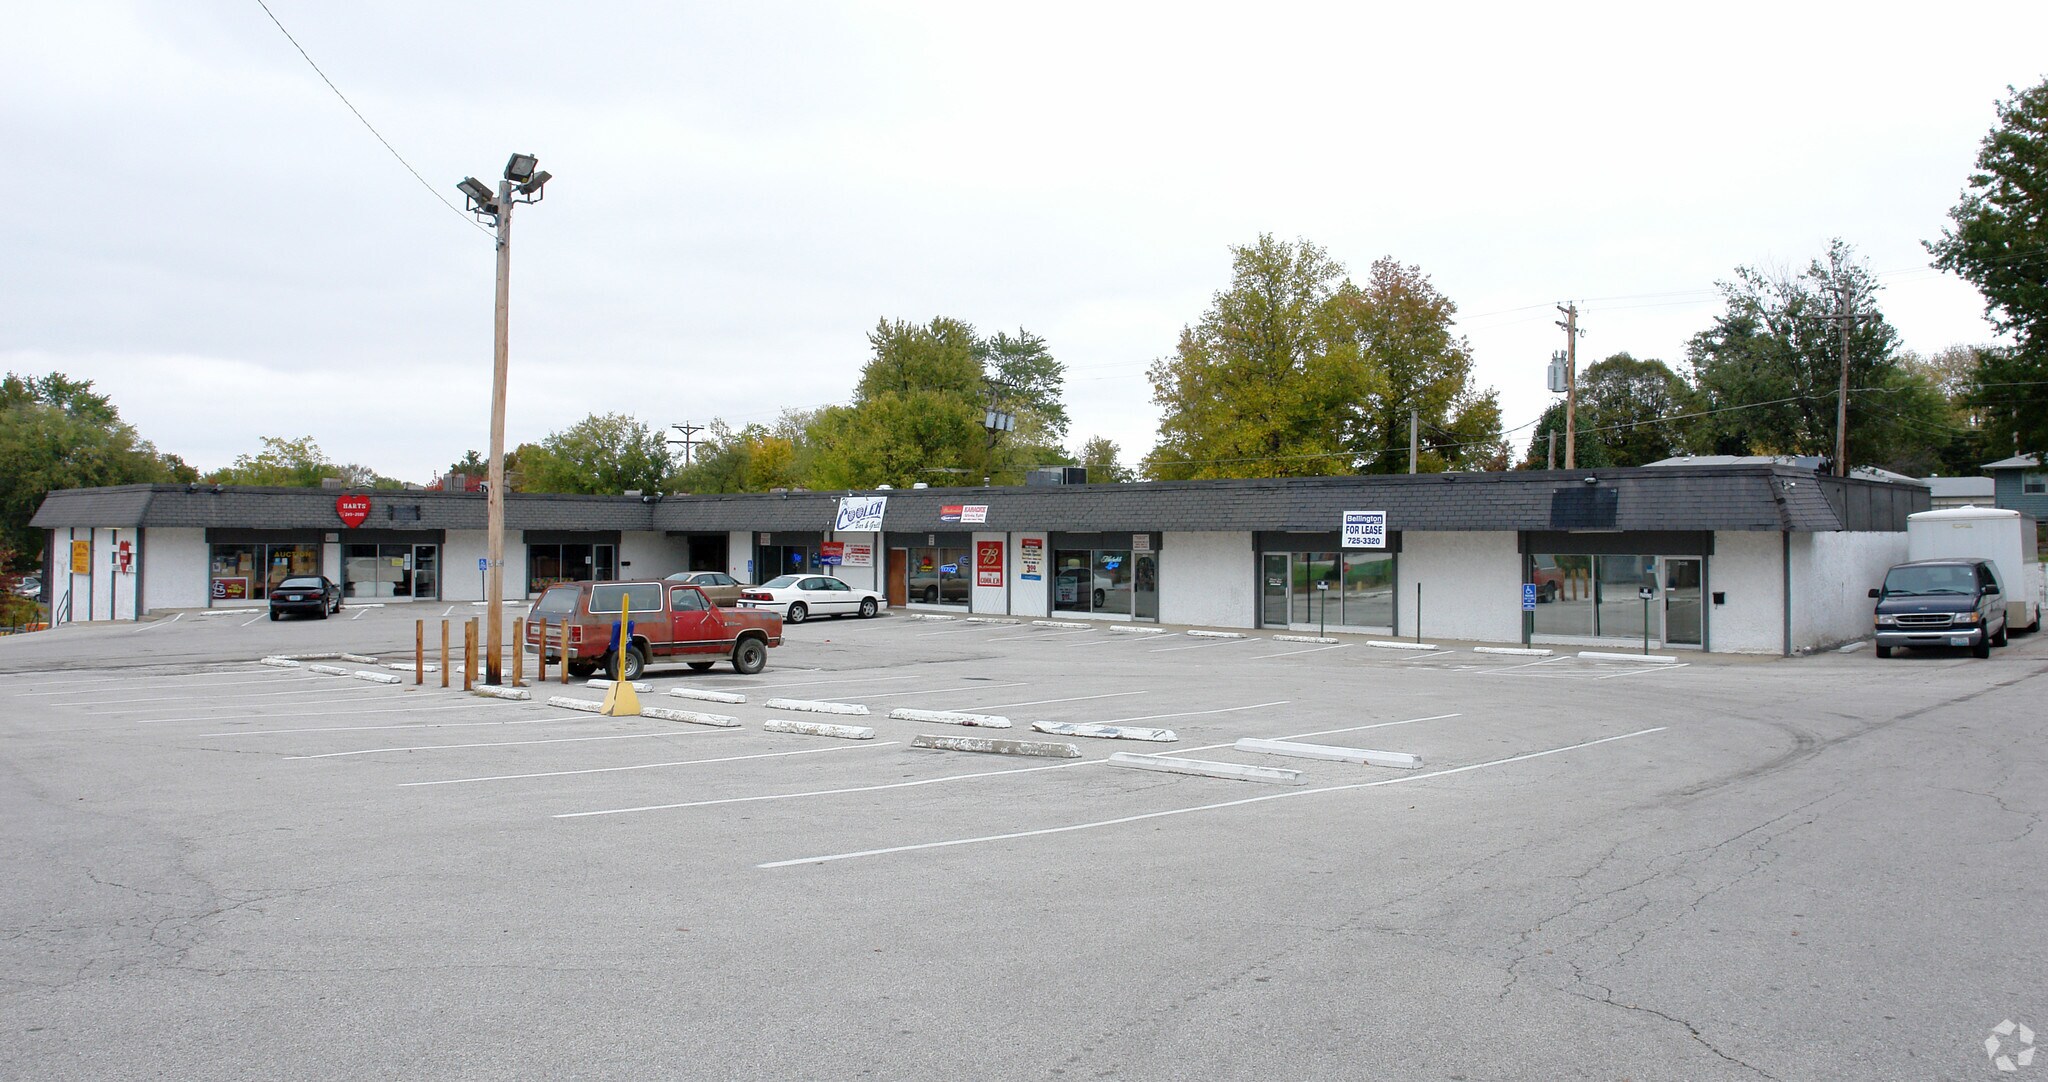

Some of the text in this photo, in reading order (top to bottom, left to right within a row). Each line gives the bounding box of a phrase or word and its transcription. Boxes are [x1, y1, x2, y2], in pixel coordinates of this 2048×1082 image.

[837, 501, 882, 530] COOLER
[1347, 515, 1382, 523] Bellington
[1345, 525, 1382, 535] FOR LEASE
[1347, 537, 1381, 545] 725-3320
